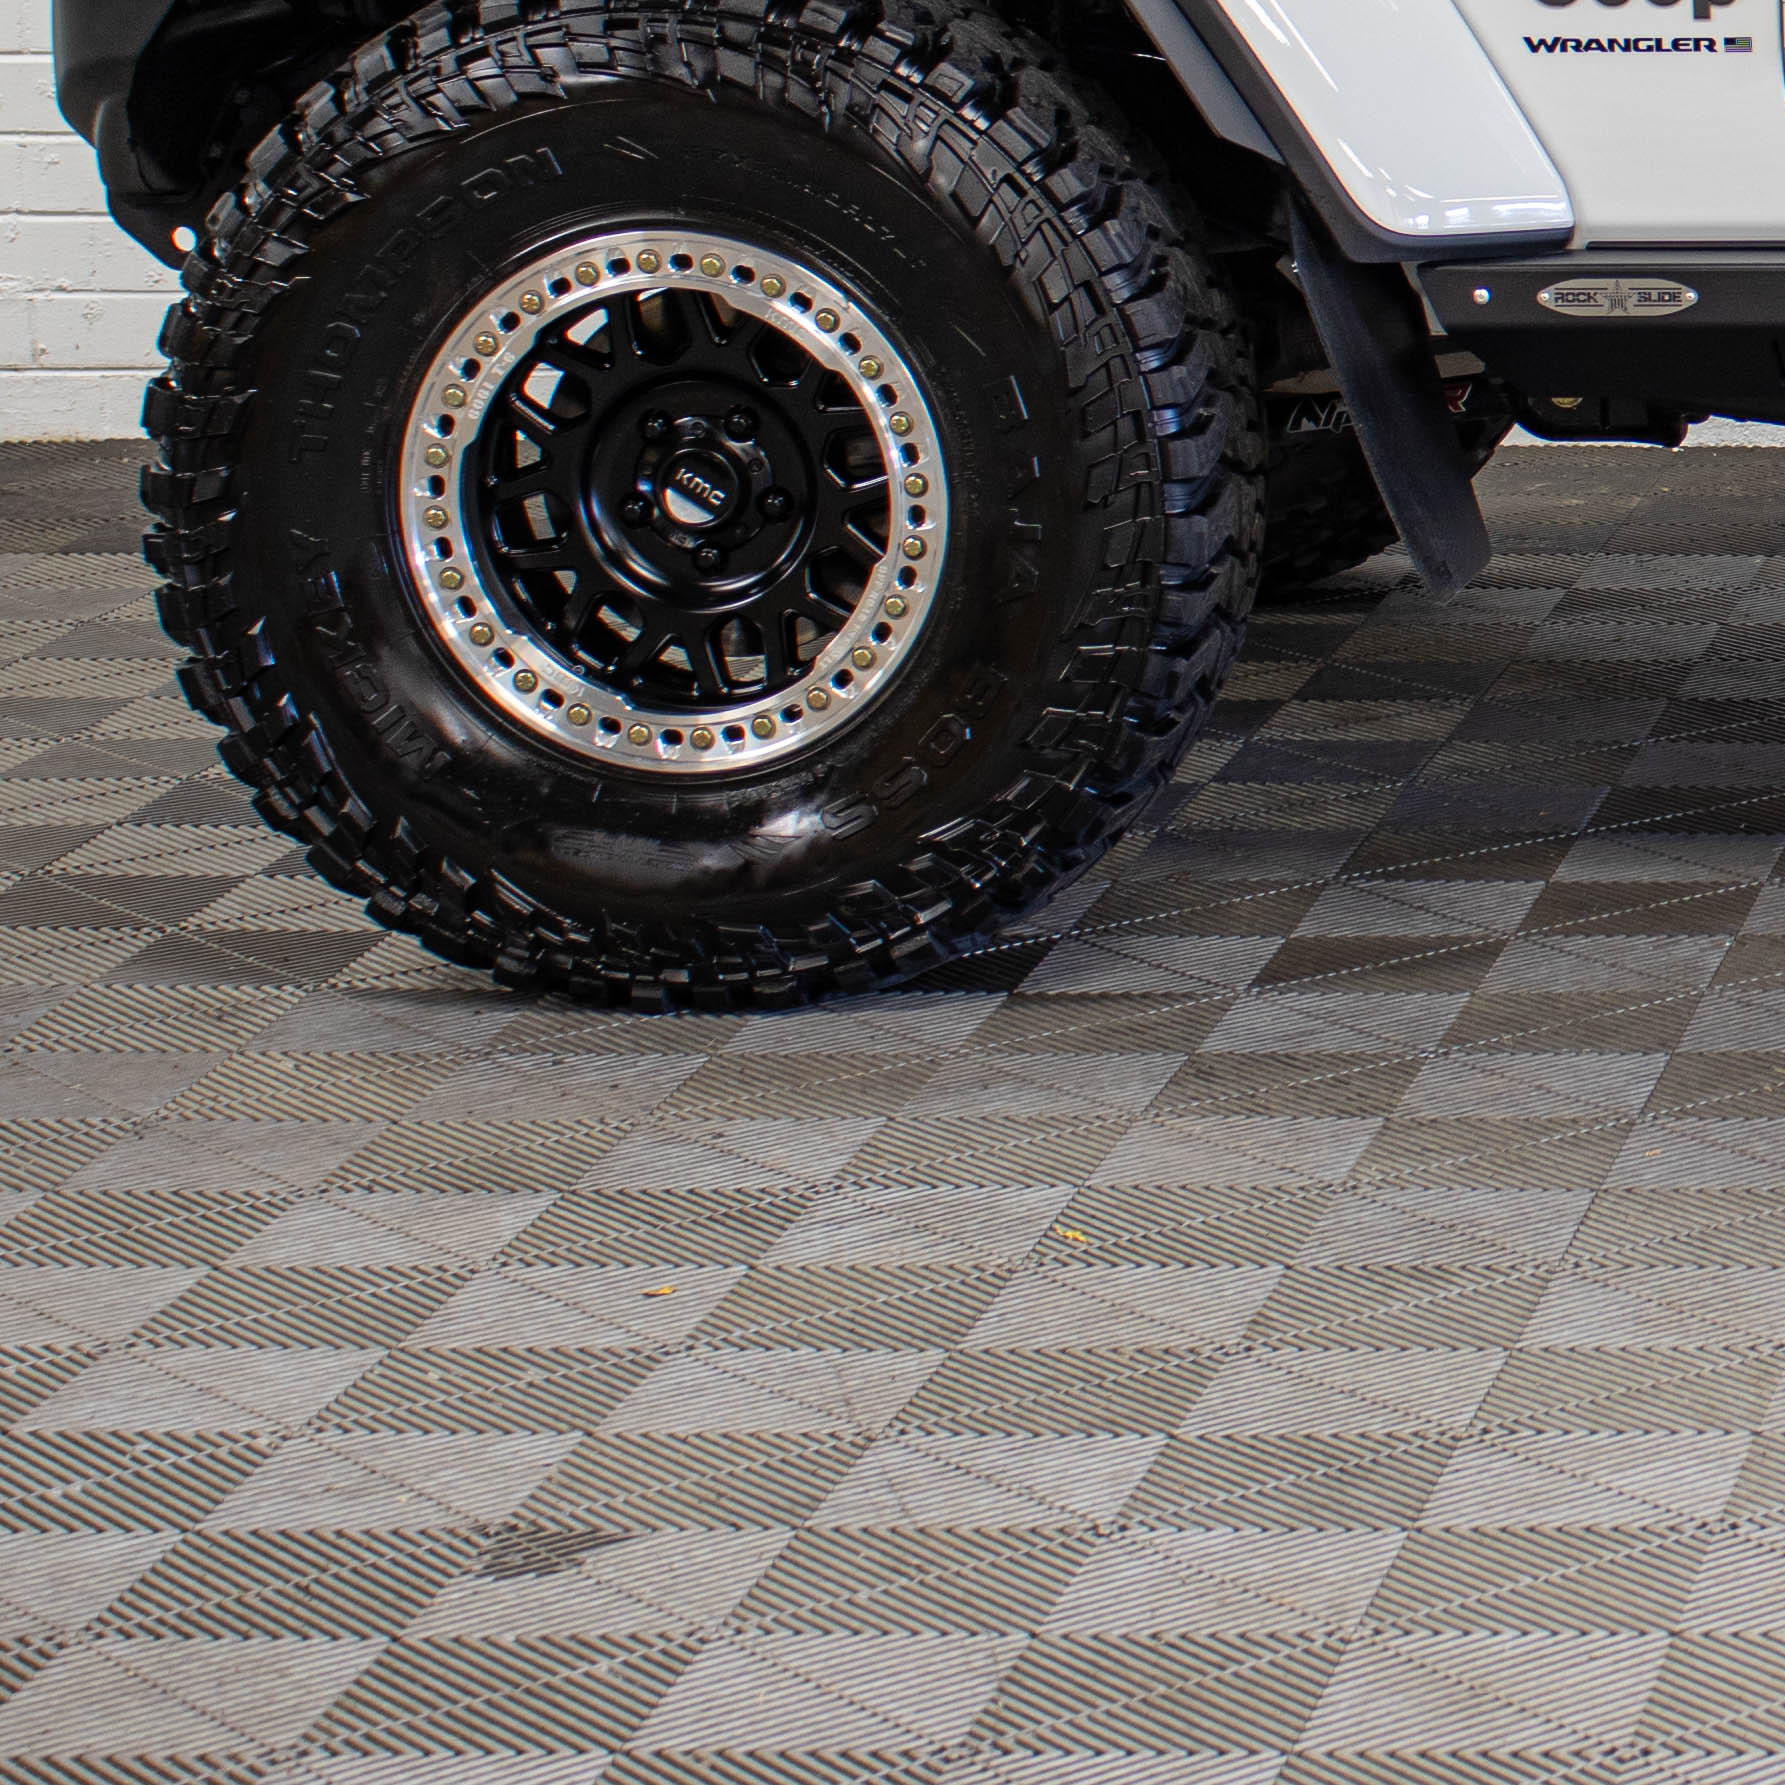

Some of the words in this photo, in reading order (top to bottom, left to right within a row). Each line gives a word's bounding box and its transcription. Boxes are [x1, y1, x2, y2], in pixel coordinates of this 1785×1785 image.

[1522, 36, 1719, 54] WRANGLER
[1554, 291, 1599, 304] ROCK
[1637, 291, 1683, 304] SLIDE
